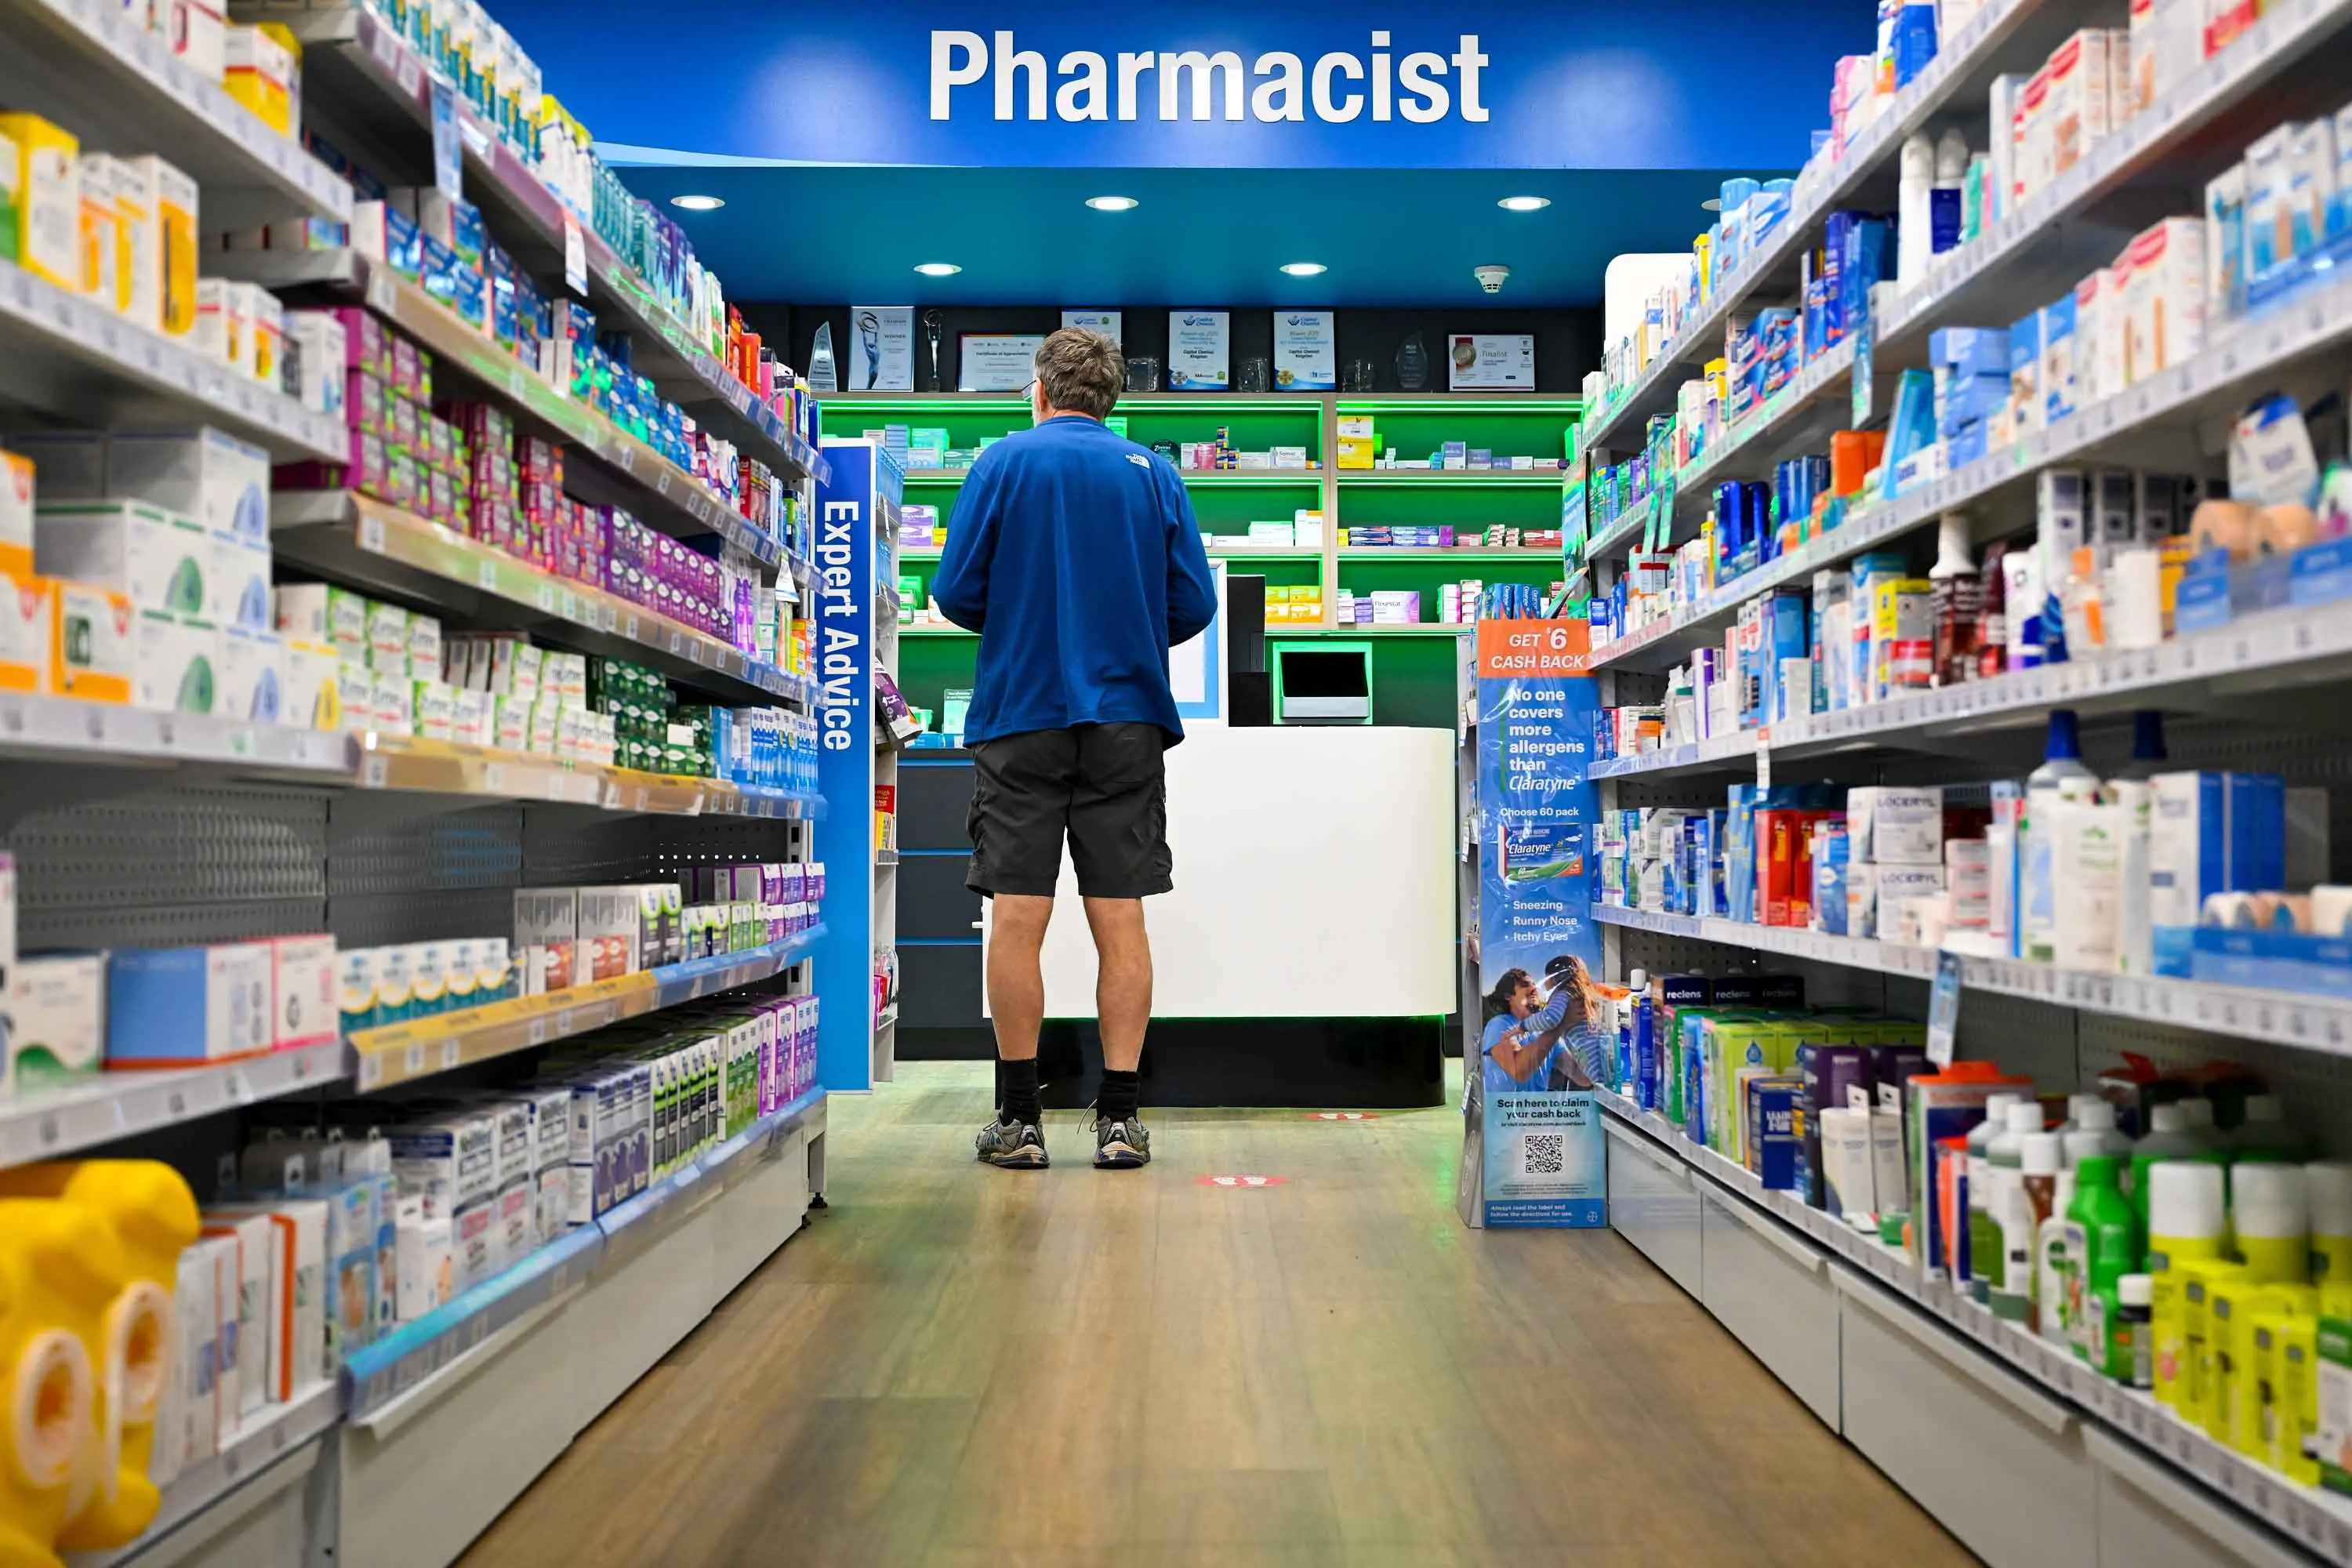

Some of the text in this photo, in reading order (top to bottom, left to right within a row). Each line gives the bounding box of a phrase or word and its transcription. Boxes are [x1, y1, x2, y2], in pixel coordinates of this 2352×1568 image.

[930, 31, 1490, 123] Pharmacist
[817, 502, 859, 750] Expert Advice
[1508, 627, 1567, 650] GET $6
[1491, 655, 1584, 669] CASH BACK
[1511, 689, 1566, 702] No one
[1508, 707, 1563, 719] covers
[1508, 724, 1552, 736] more
[1508, 740, 1584, 757] allergens
[1508, 758, 1546, 771] than
[1508, 775, 1577, 793] Claratyne
[1501, 807, 1579, 819] Choose 60 pack
[1508, 844, 1552, 855] Claratyne
[1513, 900, 1563, 912] Sneezing
[1513, 916, 1577, 928] Runny Nose
[1513, 931, 1569, 943] Itchy Eyes
[1667, 989, 1701, 999] reclens
[1715, 990, 1751, 999] reclens
[1497, 1099, 1523, 1108] Scan
[1524, 1098, 1548, 1107] here
[1562, 1098, 1589, 1107] claim
[1507, 1109, 1581, 1120] your cash back
